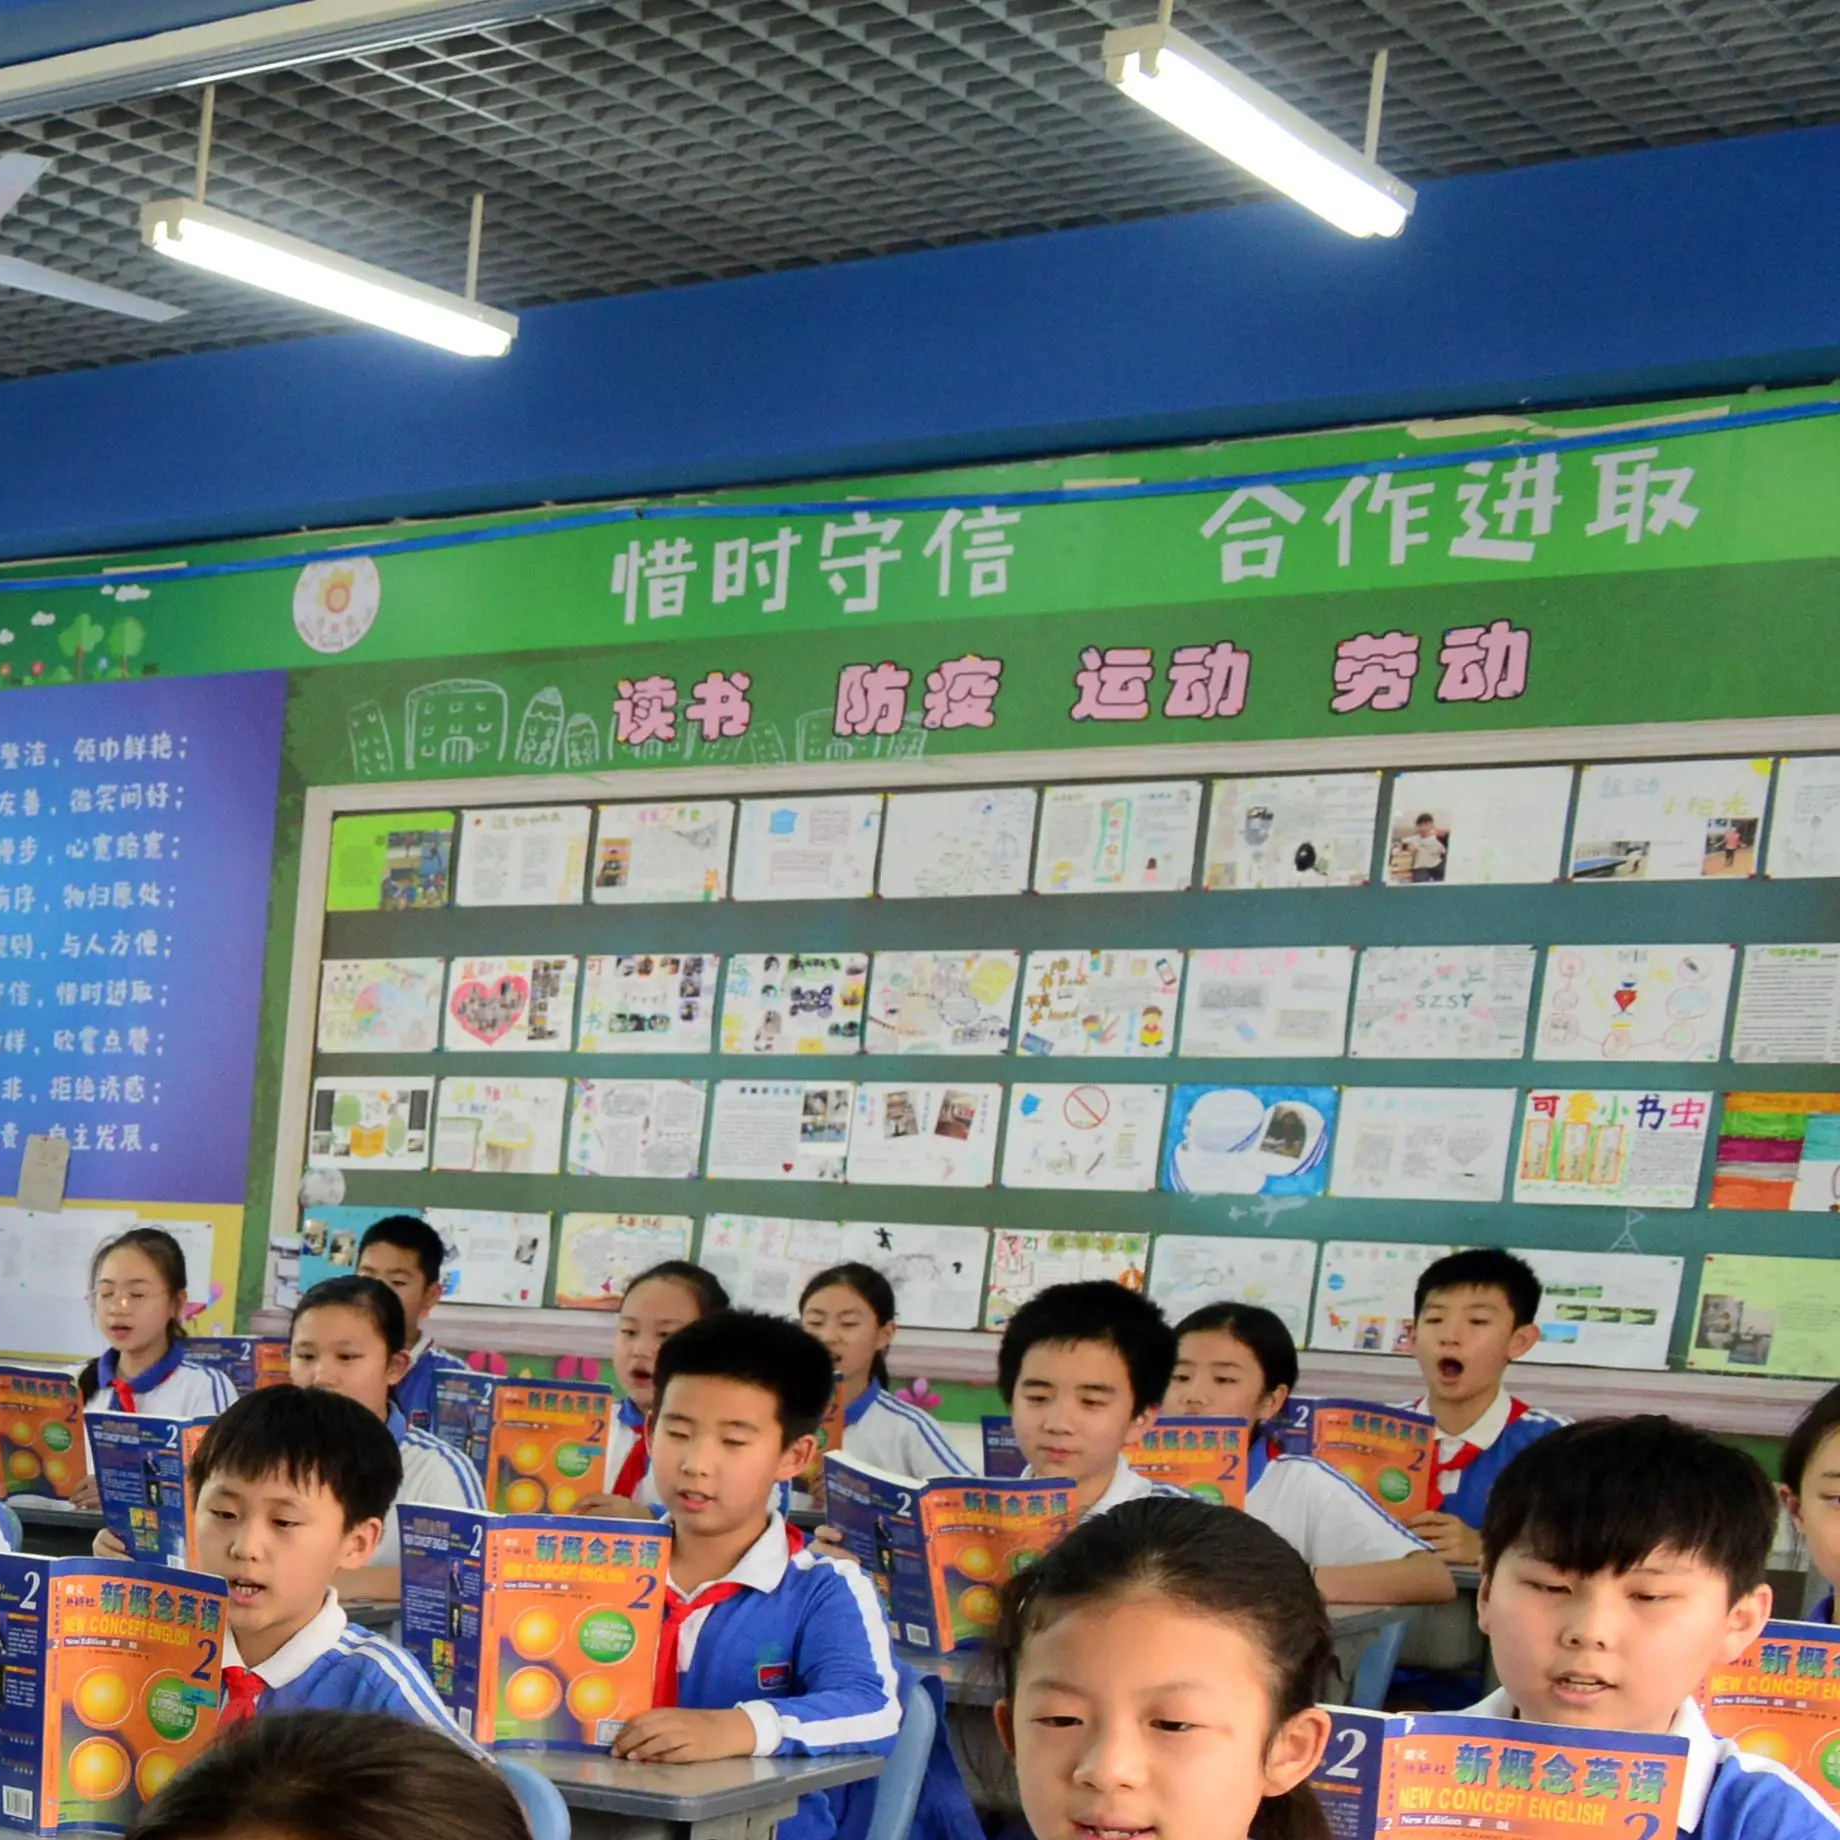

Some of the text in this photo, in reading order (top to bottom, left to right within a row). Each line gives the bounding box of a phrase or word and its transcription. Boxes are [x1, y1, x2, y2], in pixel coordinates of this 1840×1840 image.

[610, 445, 1701, 626] 惜时守信 合作进取
[612, 620, 1532, 747] 读书 防疫 运动 劳动
[1416, 992, 1473, 1009] SZSY
[241, 1342, 251, 1361] 2
[481, 1383, 493, 1405] 2
[66, 1403, 78, 1422] 2
[1294, 1405, 1309, 1427] 2
[166, 1424, 178, 1448] 2
[586, 1419, 605, 1443] 2
[1218, 1455, 1240, 1481] 2
[1408, 1449, 1426, 1471] 2
[896, 1492, 912, 1517] 2
[471, 1524, 482, 1558] 2
[536, 1534, 661, 1569] 新概念英语
[20, 1571, 40, 1610] 2
[628, 1575, 657, 1609] 2
[64, 1617, 190, 1645] NEW CONCEPT ENGLISH
[191, 1639, 218, 1681] 2
[1711, 1677, 1742, 1692] NEW
[1747, 1677, 1818, 1696] CONCEPT
[1736, 1697, 1768, 1705] Edition
[1325, 1728, 1367, 1779] 2
[1453, 1744, 1667, 1804] 新概念英语
[1399, 1787, 1607, 1825] NEW CONCEPT ENGLISH
[1383, 1818, 1393, 1830] 2
[1401, 1815, 1461, 1826] New Edition
